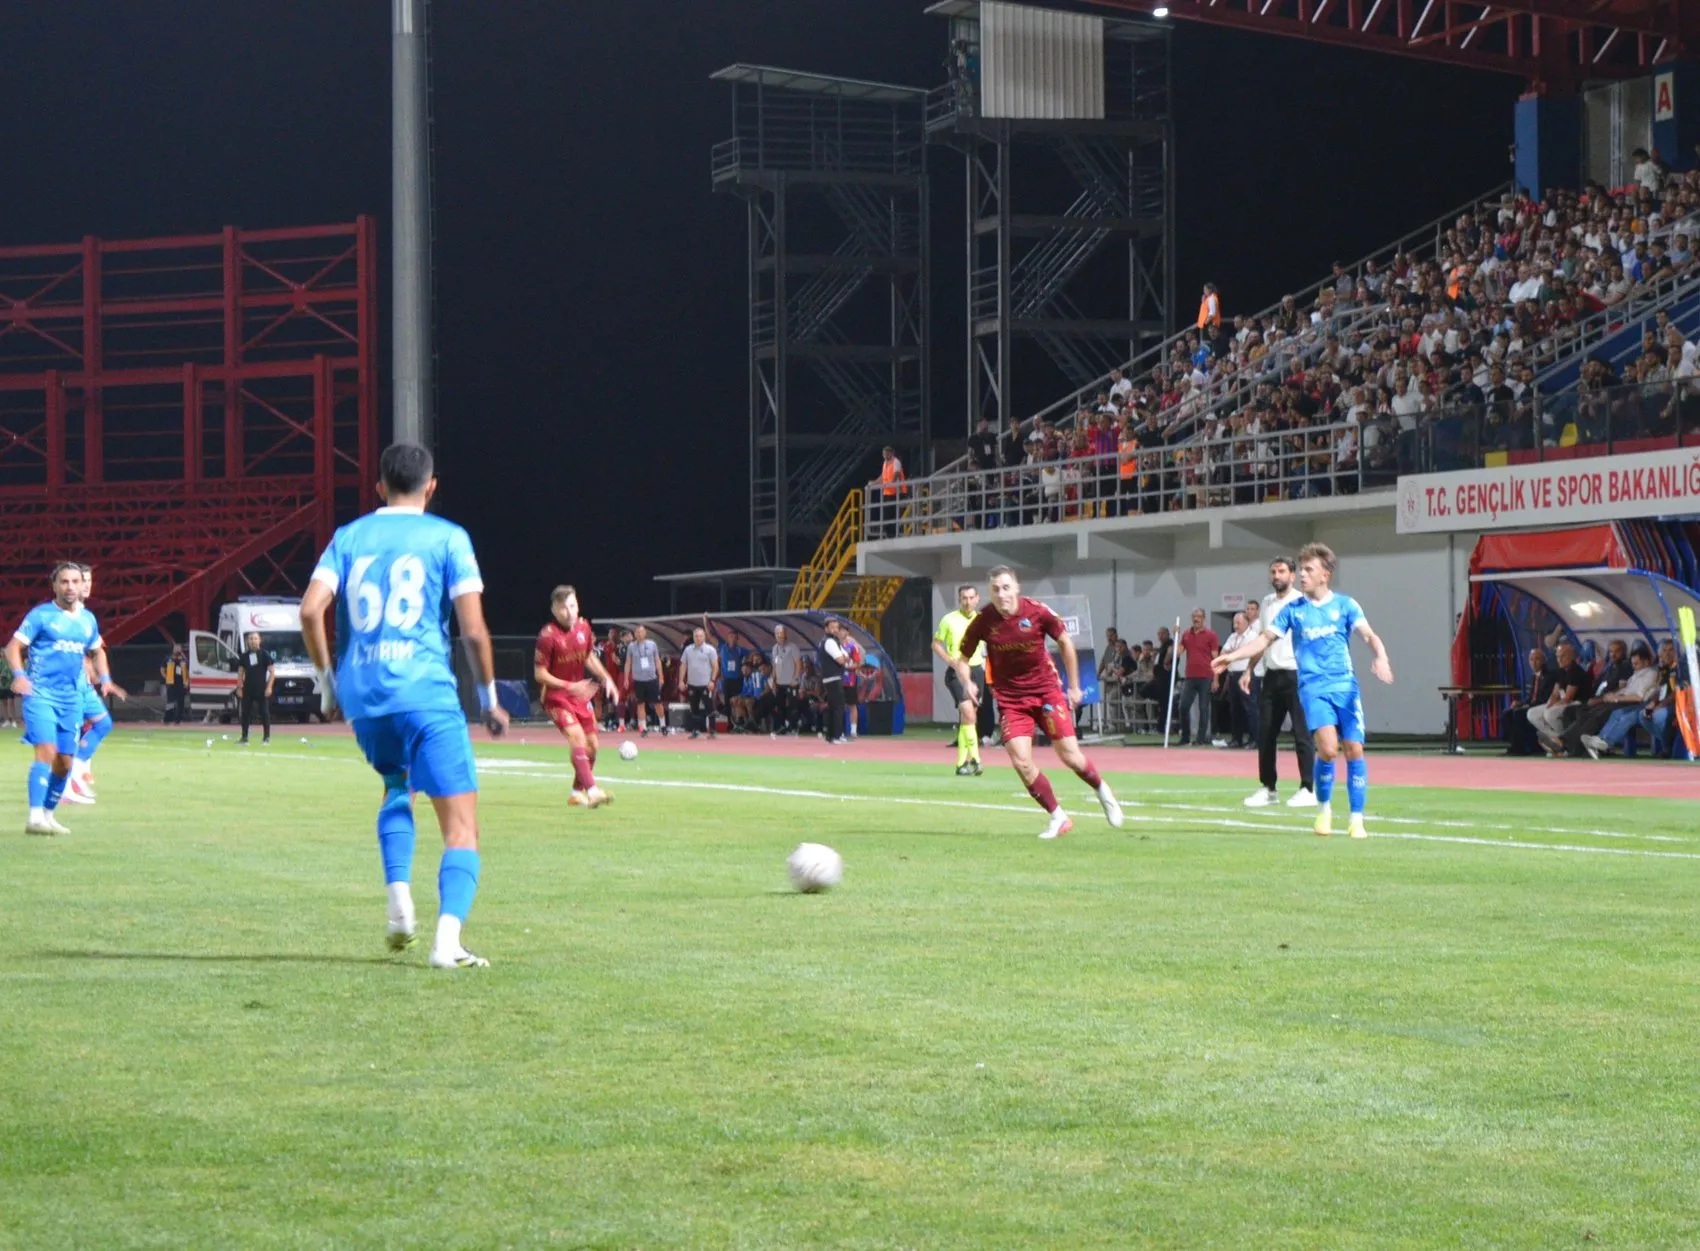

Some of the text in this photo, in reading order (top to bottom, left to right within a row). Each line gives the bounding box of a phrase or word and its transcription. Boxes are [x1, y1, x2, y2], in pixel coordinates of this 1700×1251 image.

[1657, 81, 1672, 113] A
[1425, 455, 1700, 521] T.C. GENÇLİK VE SPOR BAKANLIĞ
[346, 552, 426, 633] 68
